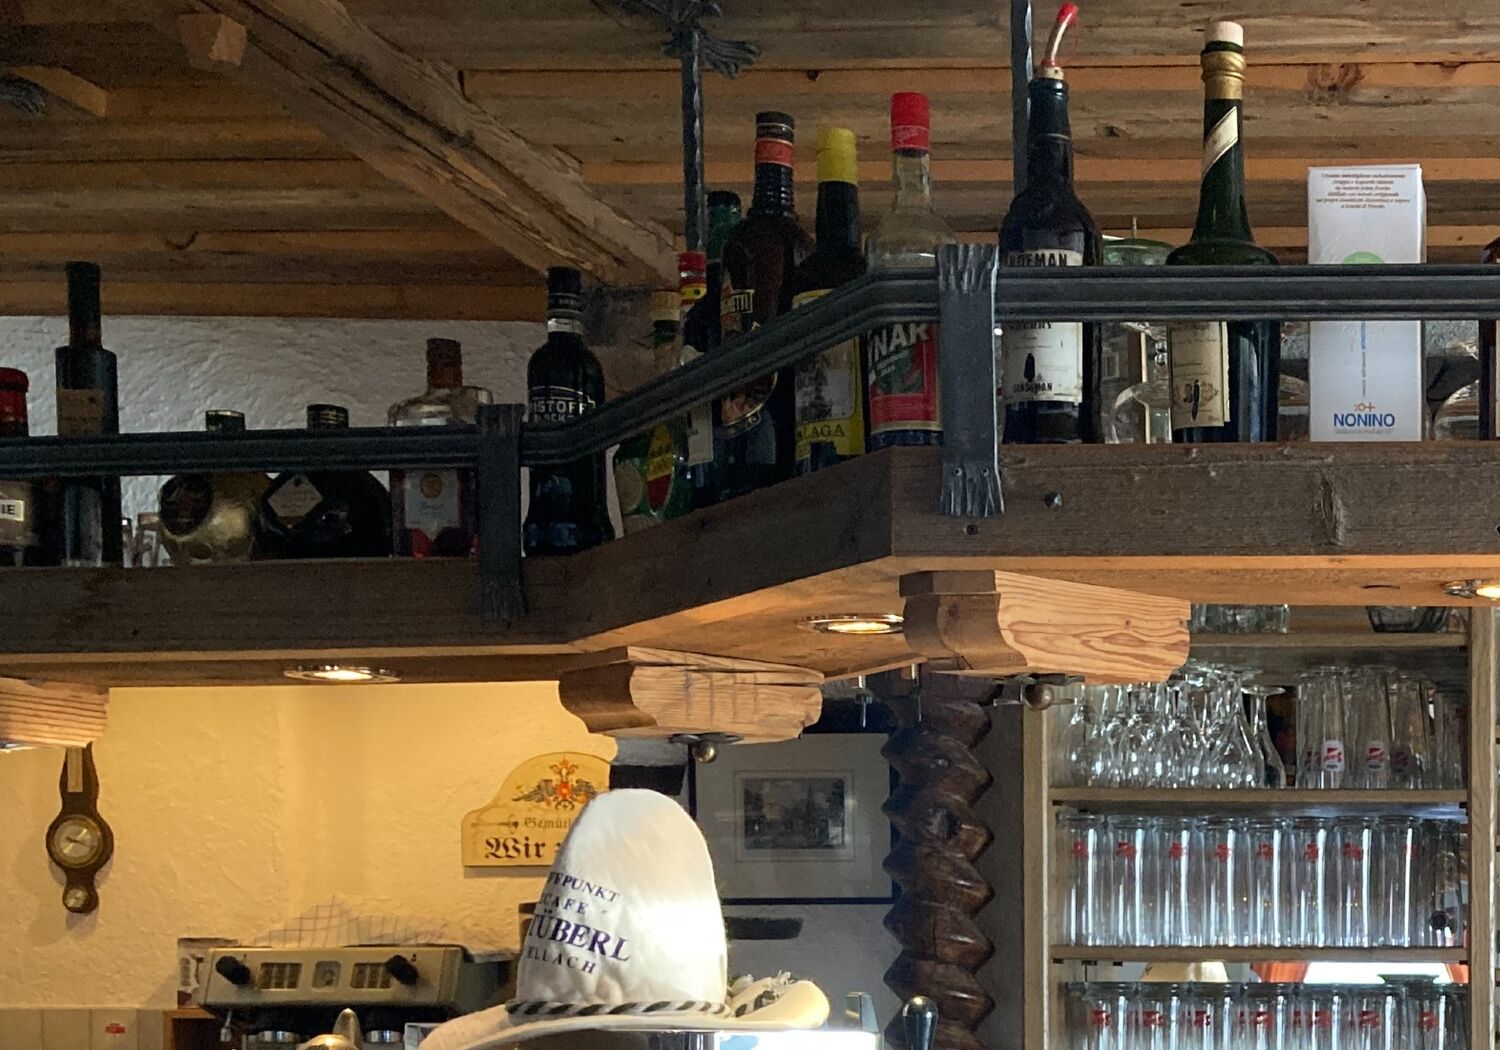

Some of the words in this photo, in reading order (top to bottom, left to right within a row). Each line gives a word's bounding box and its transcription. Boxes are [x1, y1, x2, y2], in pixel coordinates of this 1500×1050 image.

[1333, 413, 1395, 428] NONINO
[0, 504, 15, 515] IE
[484, 836, 546, 859] Wir
